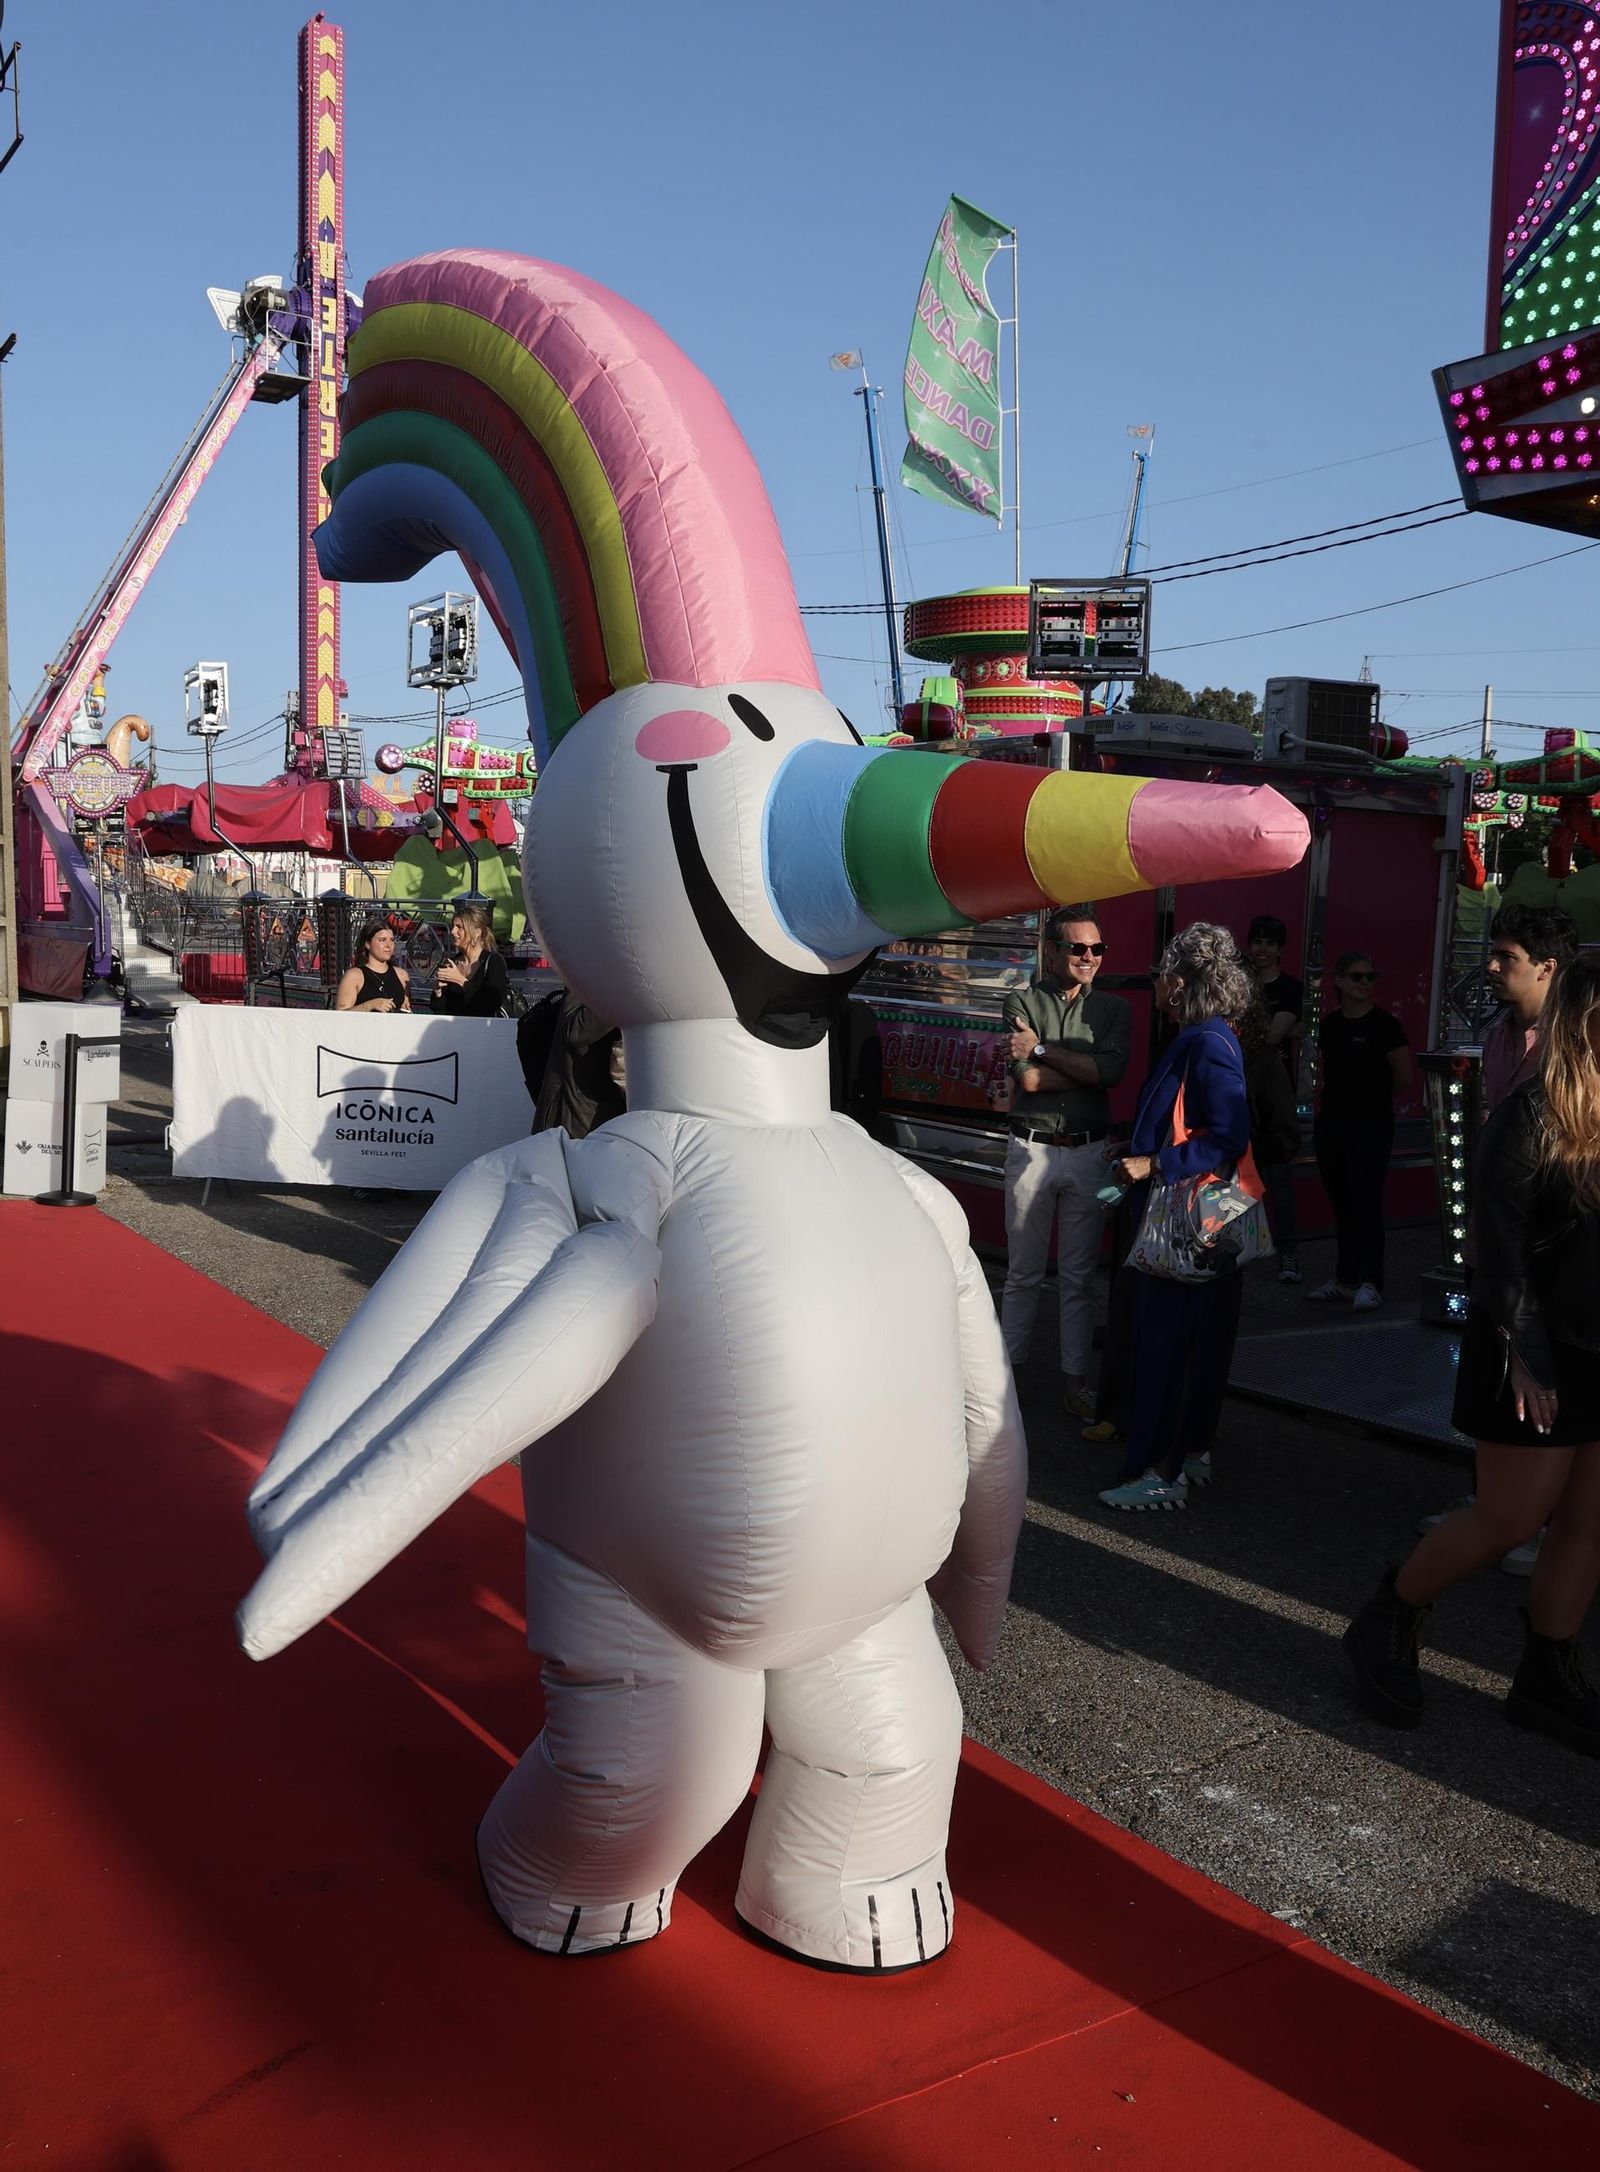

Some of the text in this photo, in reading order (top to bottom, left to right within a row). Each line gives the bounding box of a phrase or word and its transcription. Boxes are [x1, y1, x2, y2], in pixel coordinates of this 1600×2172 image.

[23, 1058, 61, 1070] SCALPERS
[335, 1127, 434, 1145] santalucía
[361, 1149, 389, 1157] SEVILLA
